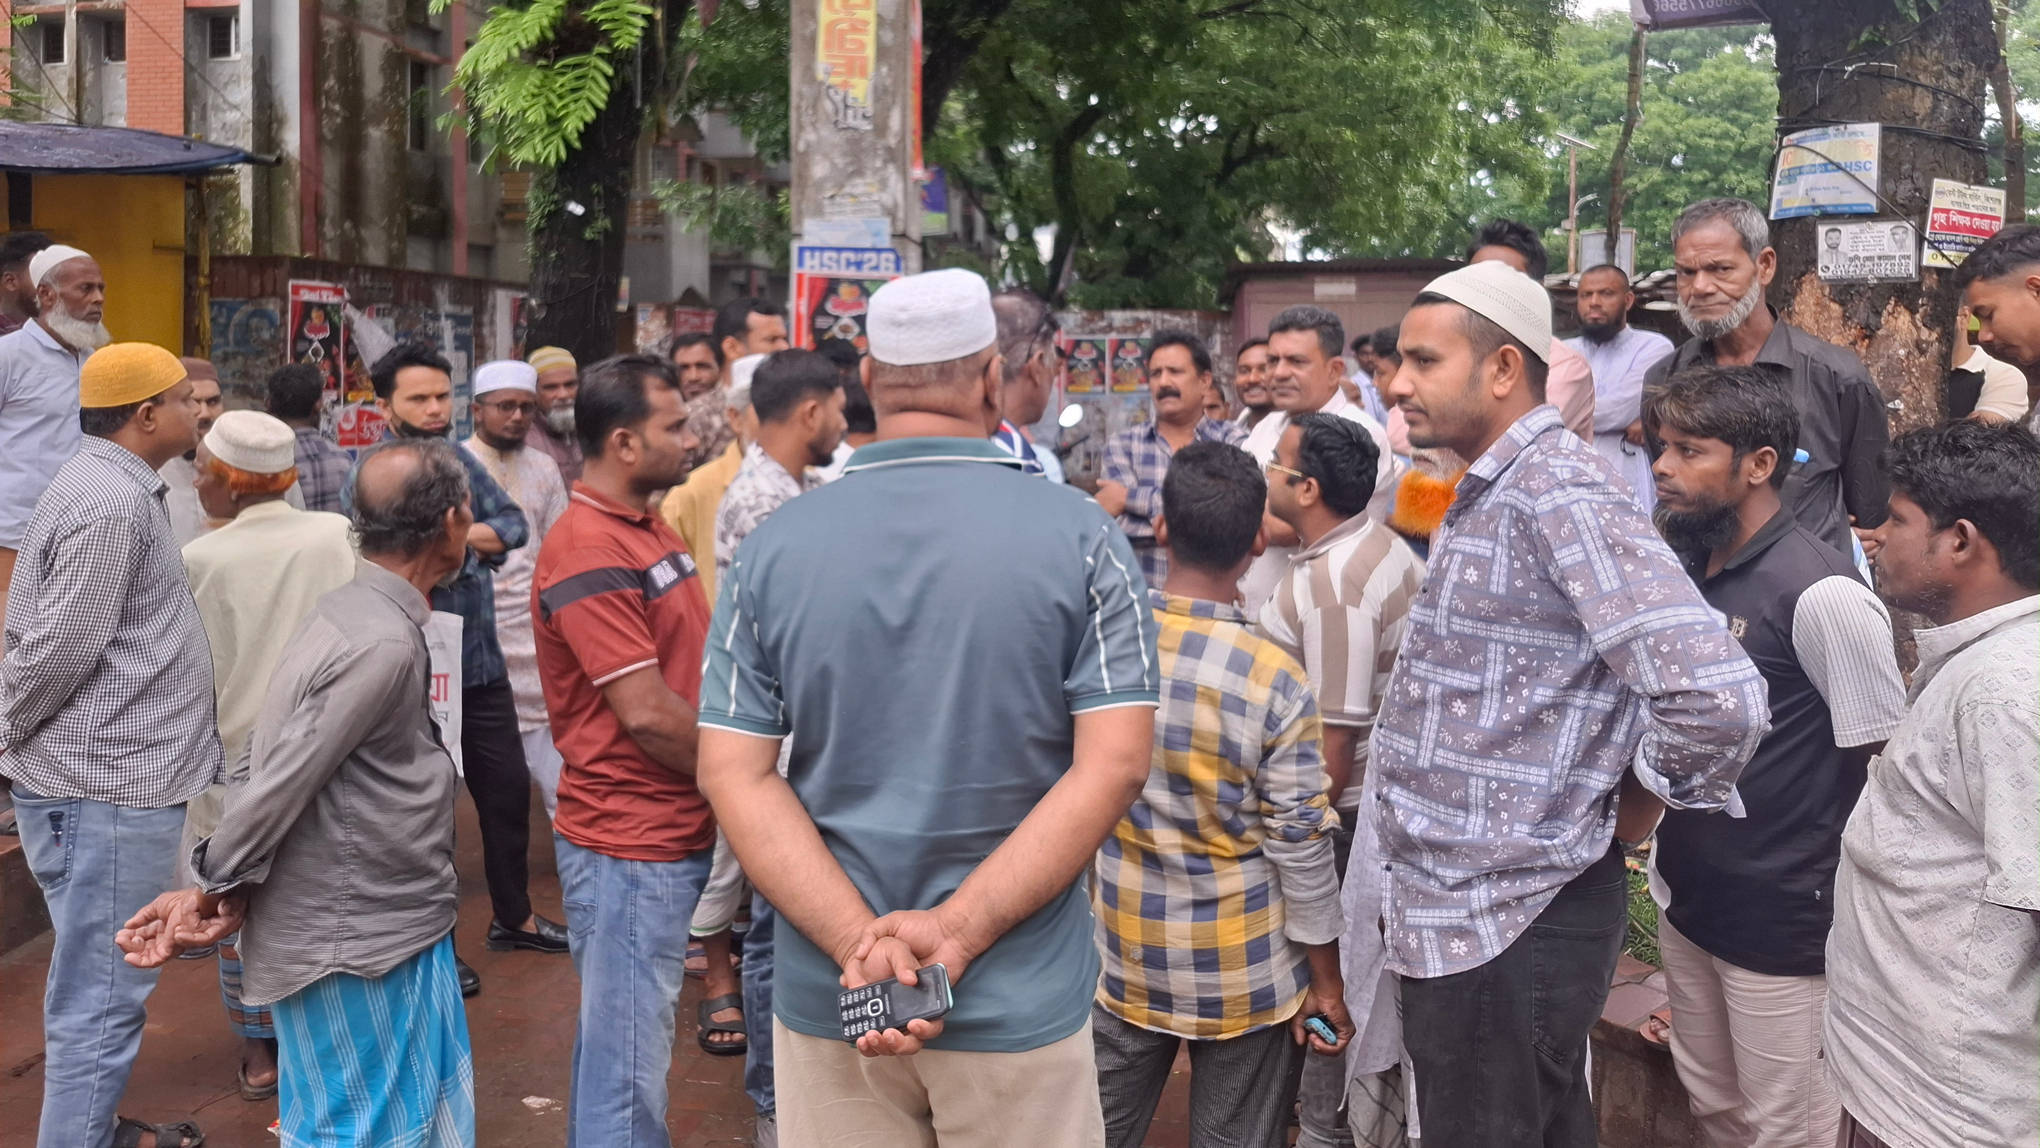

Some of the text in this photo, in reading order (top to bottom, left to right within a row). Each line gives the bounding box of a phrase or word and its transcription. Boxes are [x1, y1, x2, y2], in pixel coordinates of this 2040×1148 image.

[1844, 160, 1873, 172] HSC
[1933, 212, 1948, 229] গৃহ
[1949, 210, 1971, 228] শিক্ষক
[803, 250, 897, 272] HSC'26
